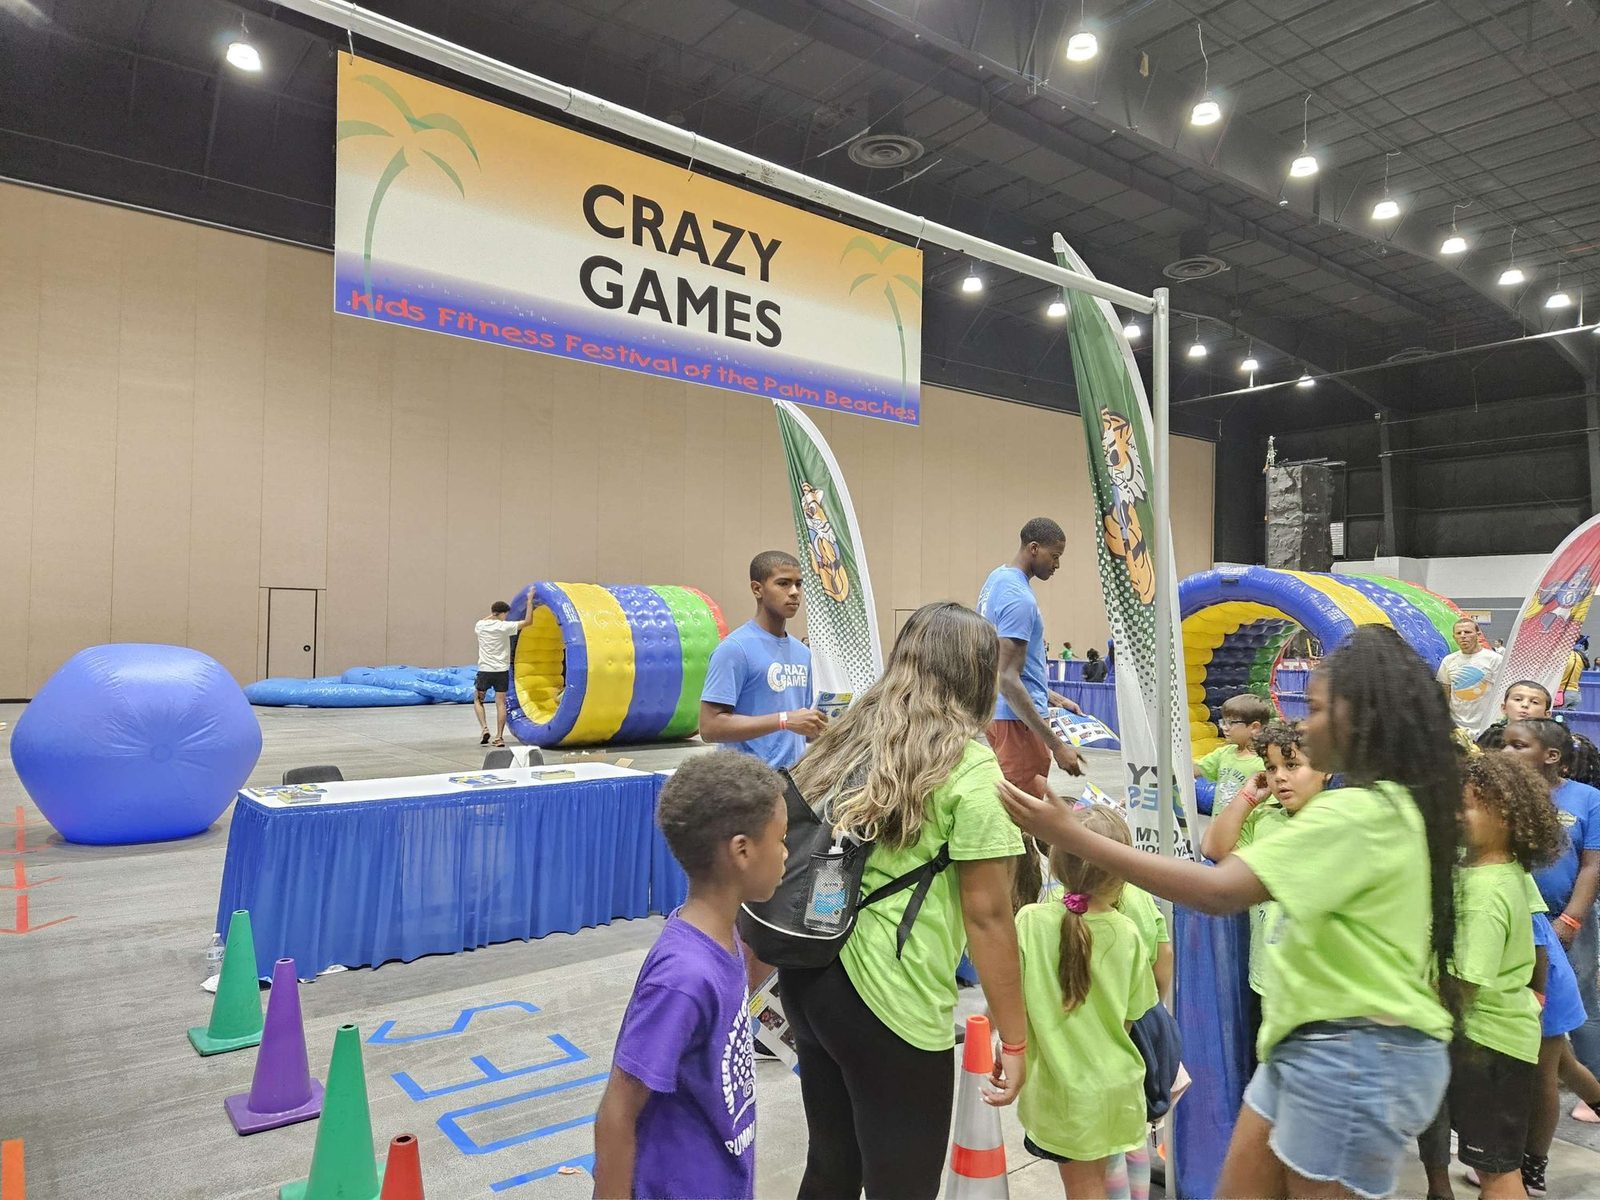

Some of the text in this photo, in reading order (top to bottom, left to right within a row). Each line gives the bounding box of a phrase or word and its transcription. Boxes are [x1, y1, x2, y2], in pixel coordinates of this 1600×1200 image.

[582, 184, 783, 283] CRAZY
[579, 255, 782, 347] GAMES
[351, 290, 917, 421] Kids Fitness Festival of the Palm Beaches
